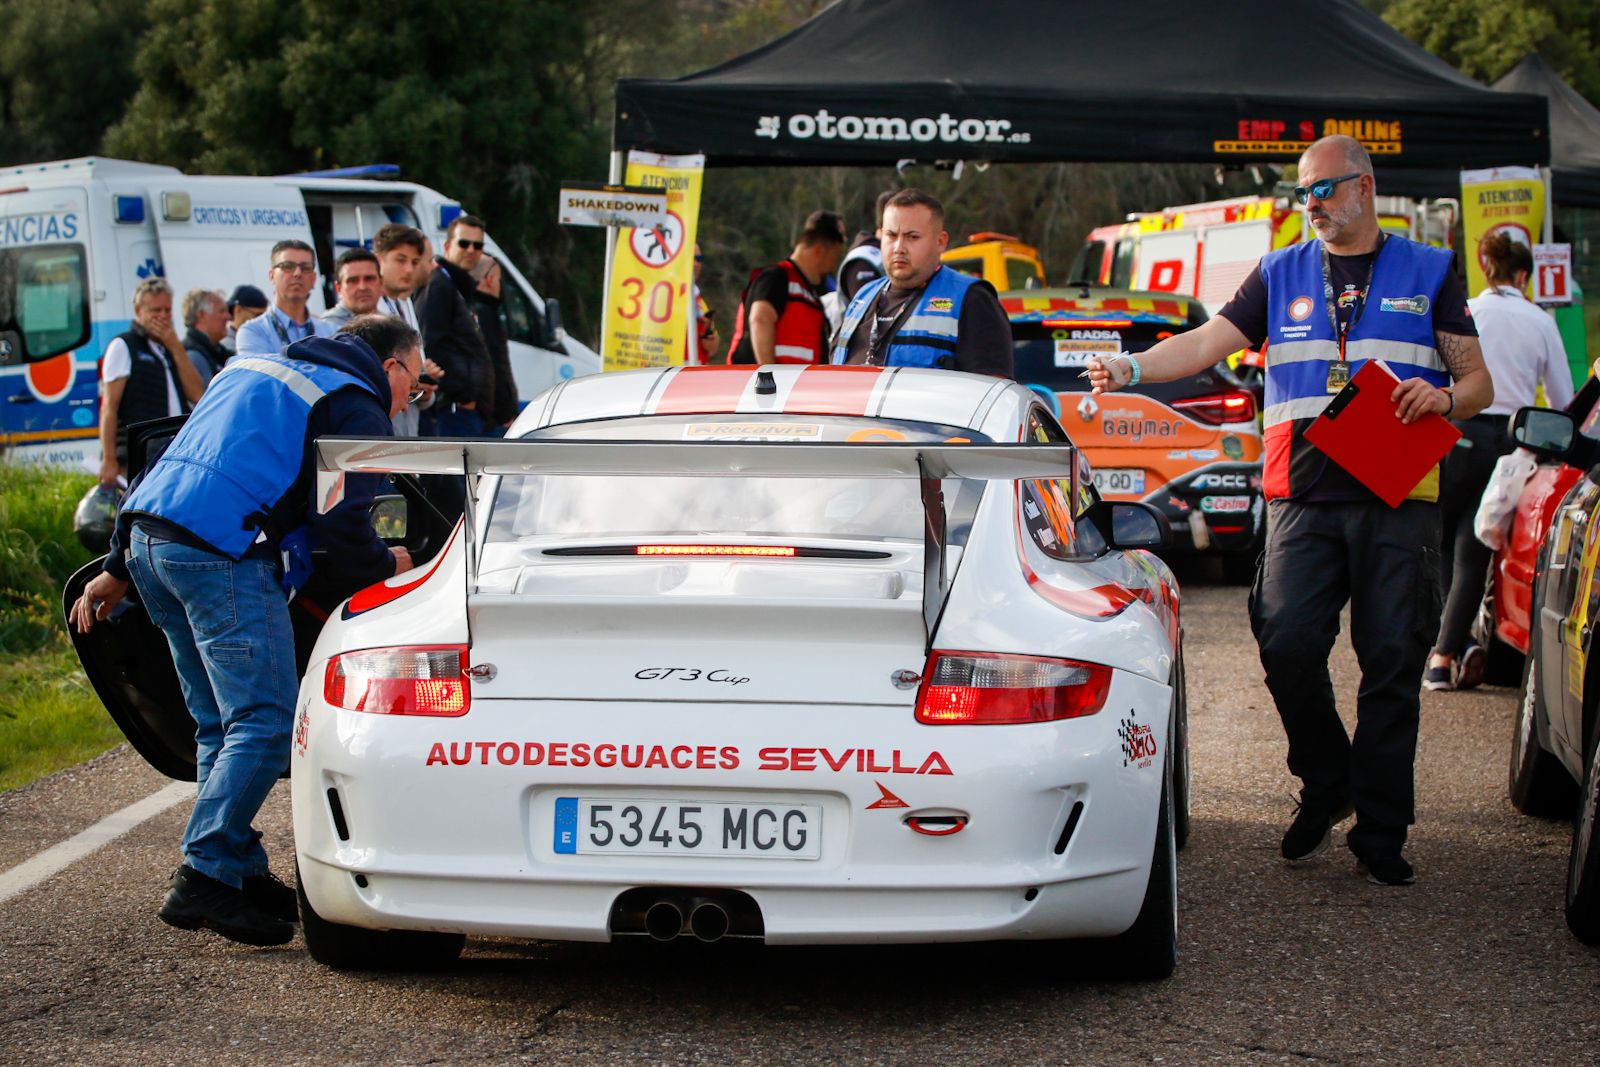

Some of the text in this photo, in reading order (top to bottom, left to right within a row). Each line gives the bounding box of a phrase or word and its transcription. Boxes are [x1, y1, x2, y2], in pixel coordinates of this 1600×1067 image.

[1323, 118, 1402, 141] ONLINE
[568, 197, 660, 213] SHAKEDOWN
[242, 208, 250, 223] Y
[250, 208, 306, 227] URGENCIAS
[1071, 330, 1122, 340] RADSA
[706, 669, 751, 686] Cup
[425, 741, 954, 776] AUTODESGUACES SEVILLA
[590, 805, 808, 851] 5345 MCG
[561, 831, 572, 844] E
